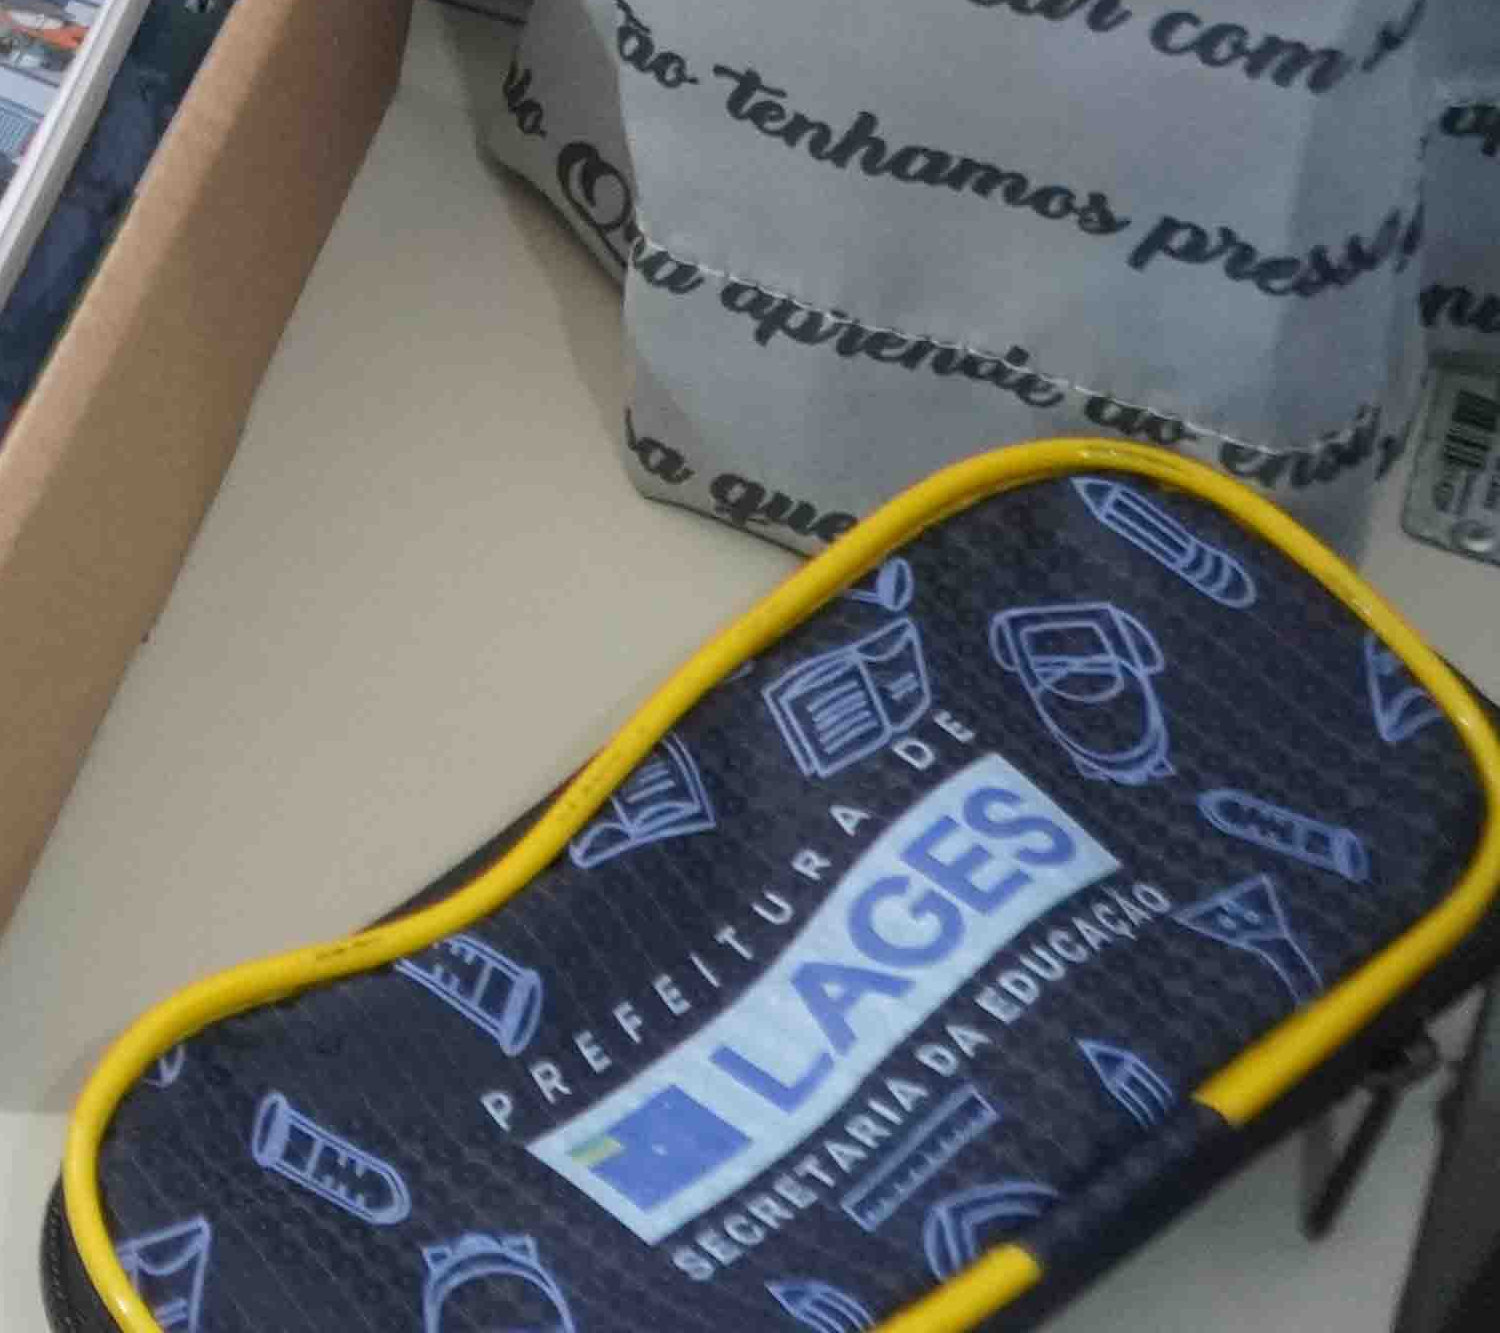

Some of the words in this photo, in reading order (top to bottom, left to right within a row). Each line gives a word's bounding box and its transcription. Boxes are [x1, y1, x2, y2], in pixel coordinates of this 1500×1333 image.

[711, 60, 1132, 236] tenhamos
[1149, 5, 1352, 93] com
[480, 802, 888, 1133] PREFEITURA
[891, 708, 977, 771] DE
[672, 1073, 929, 1281] SECRETARIA
[915, 1022, 992, 1078] DA
[976, 880, 1174, 1026] EDUCAÇÃO
[707, 785, 1078, 1116] LAGES
